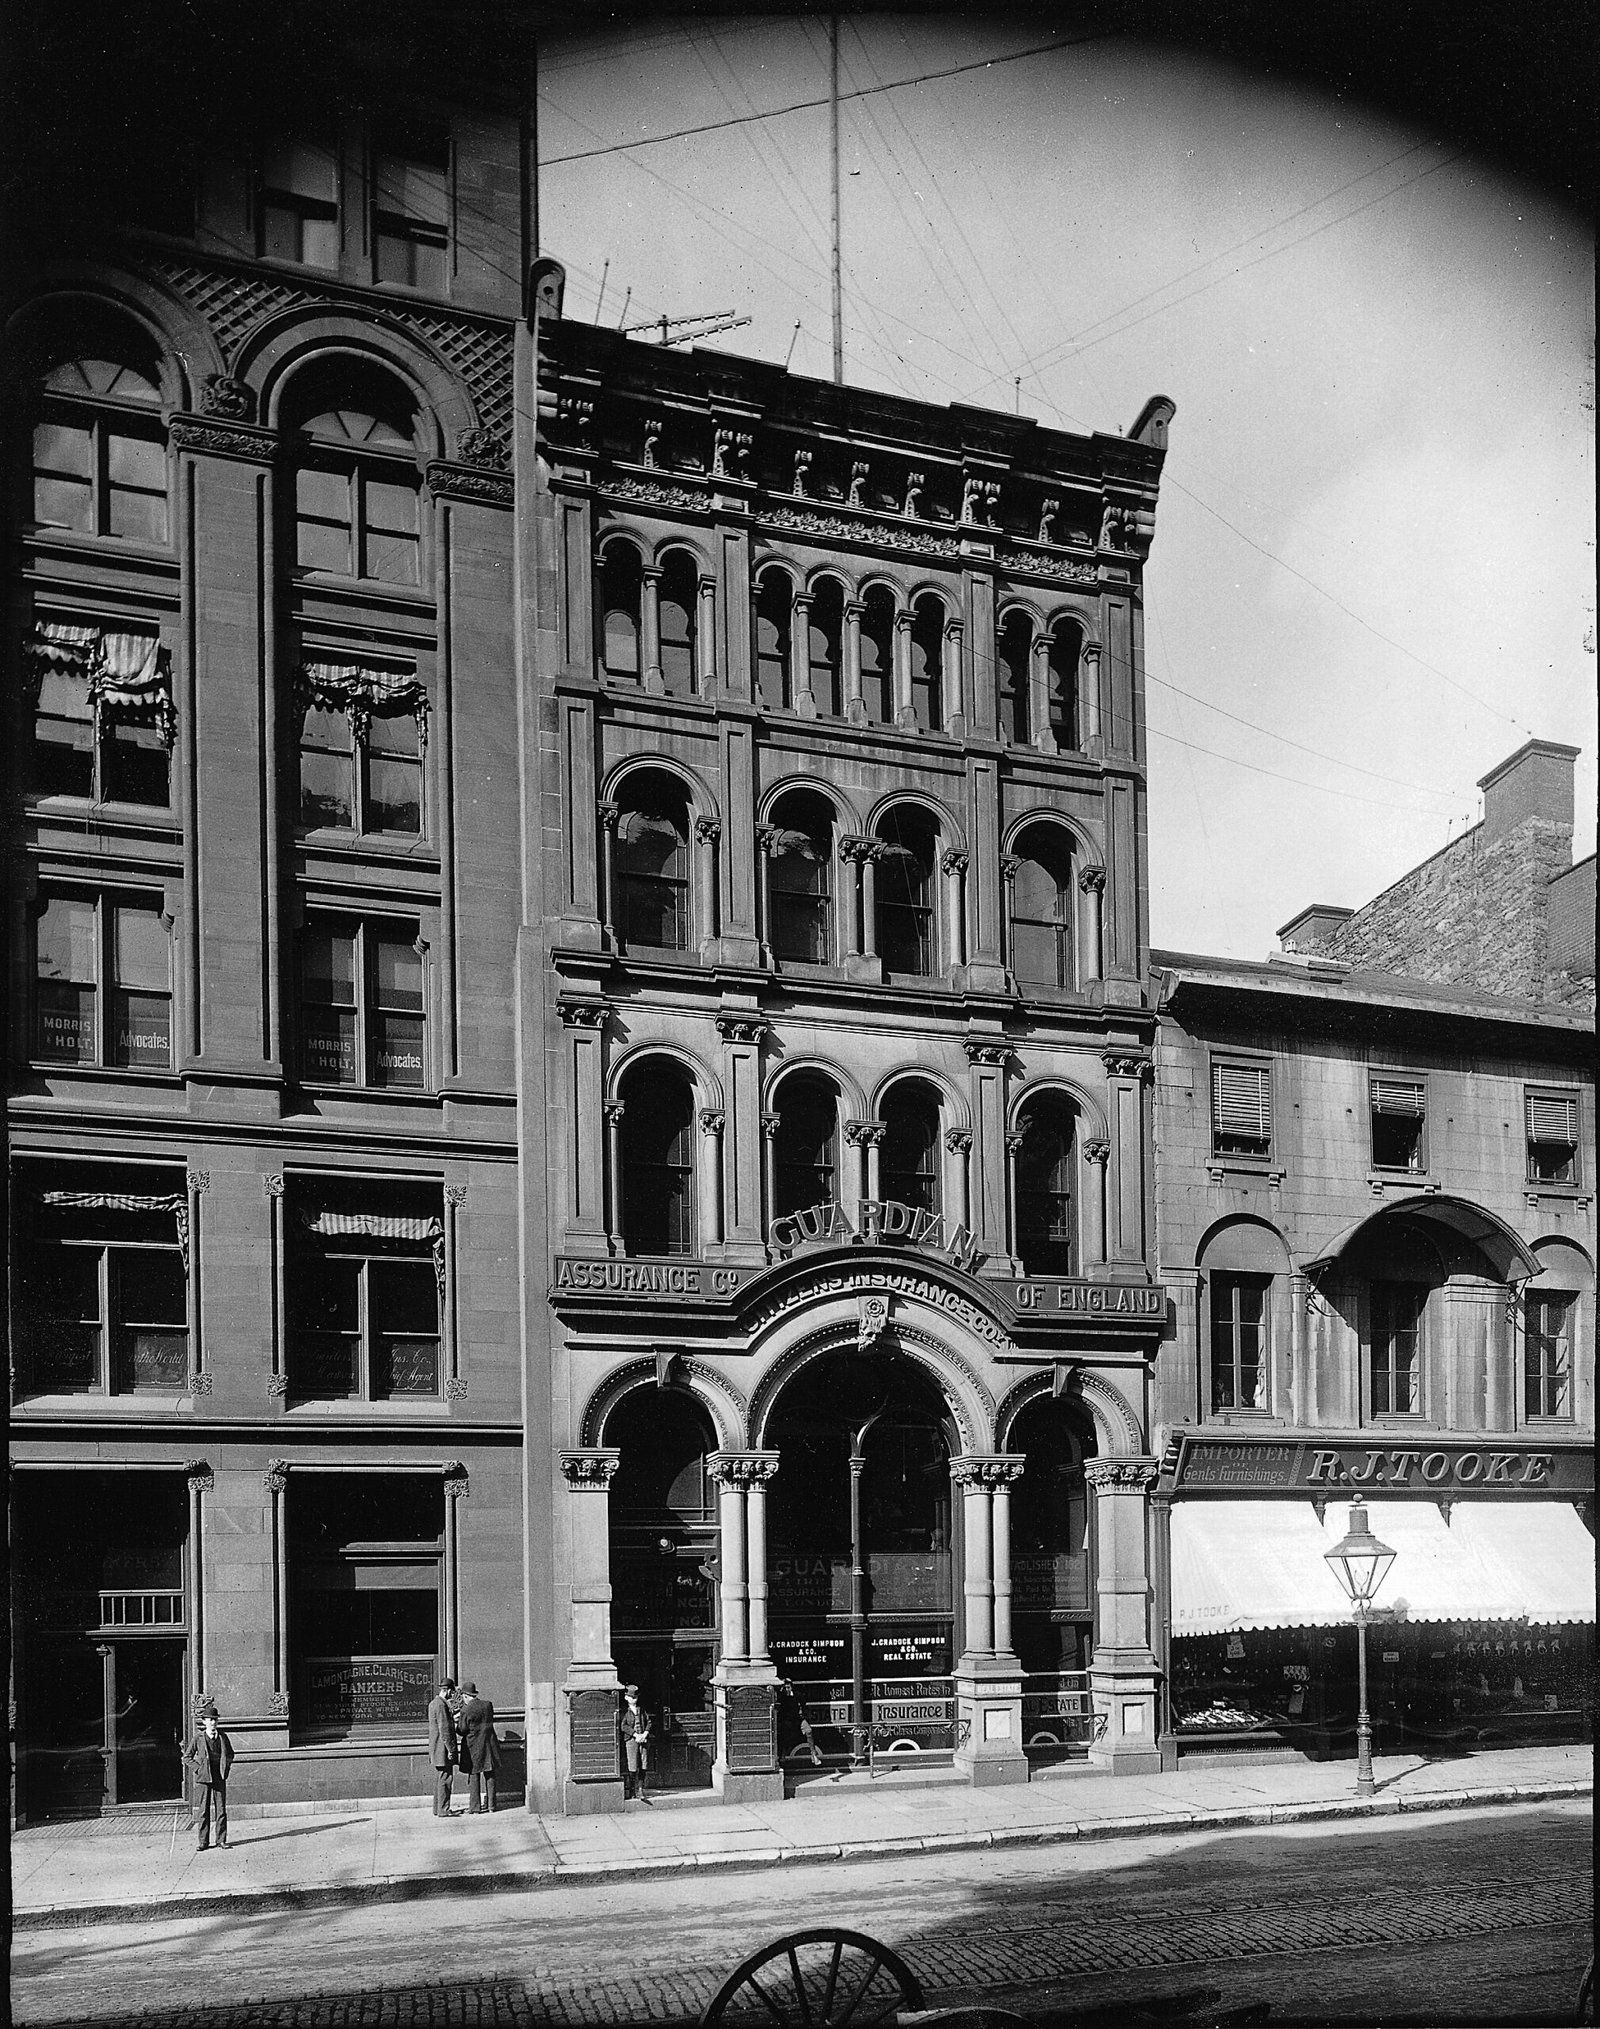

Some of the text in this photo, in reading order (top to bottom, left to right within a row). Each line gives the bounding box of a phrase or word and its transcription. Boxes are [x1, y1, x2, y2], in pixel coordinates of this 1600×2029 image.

[44, 1016, 91, 1032] MORRIS
[55, 1035, 93, 1050] HOLT.
[119, 1029, 170, 1049] Advocates.
[308, 1039, 351, 1053] MORRIS
[319, 1056, 354, 1070] HOLT.
[377, 1051, 423, 1069] Advocates.
[769, 1199, 979, 1262] GUARDIAN
[557, 1260, 702, 1293] ASSURANCE
[1016, 1284, 1160, 1313] OF ENGLAND
[1191, 1445, 1290, 1461] IMPORTER
[812, 1639, 845, 1648] SIMPSON
[913, 1637, 946, 1645] SIMPSON
[785, 1655, 827, 1664] INSURANCE
[883, 1652, 932, 1661] REAL ESTATE
[340, 1682, 404, 1694] BANKERS
[810, 1707, 847, 1721] STATE
[877, 1704, 943, 1721] Insurance
